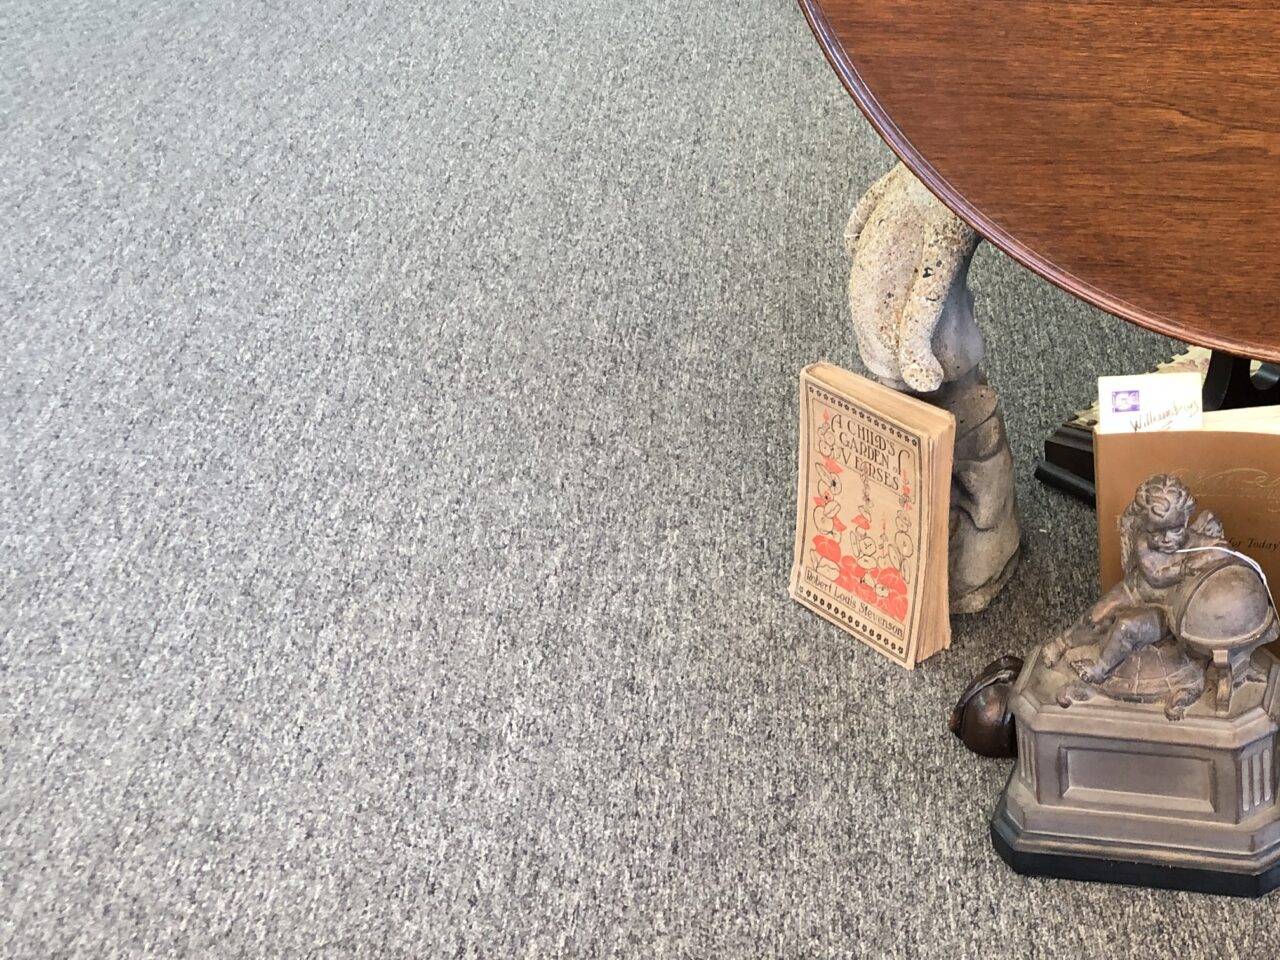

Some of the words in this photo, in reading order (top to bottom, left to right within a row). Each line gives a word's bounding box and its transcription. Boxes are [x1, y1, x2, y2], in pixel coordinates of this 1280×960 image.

[831, 414, 842, 432] A
[847, 420, 895, 456] CHILD'S
[840, 431, 889, 469] GARDEN
[841, 448, 899, 491] VERSES
[806, 570, 832, 592] Robert
[834, 586, 857, 608] Louis
[859, 601, 903, 637] Stevenson
